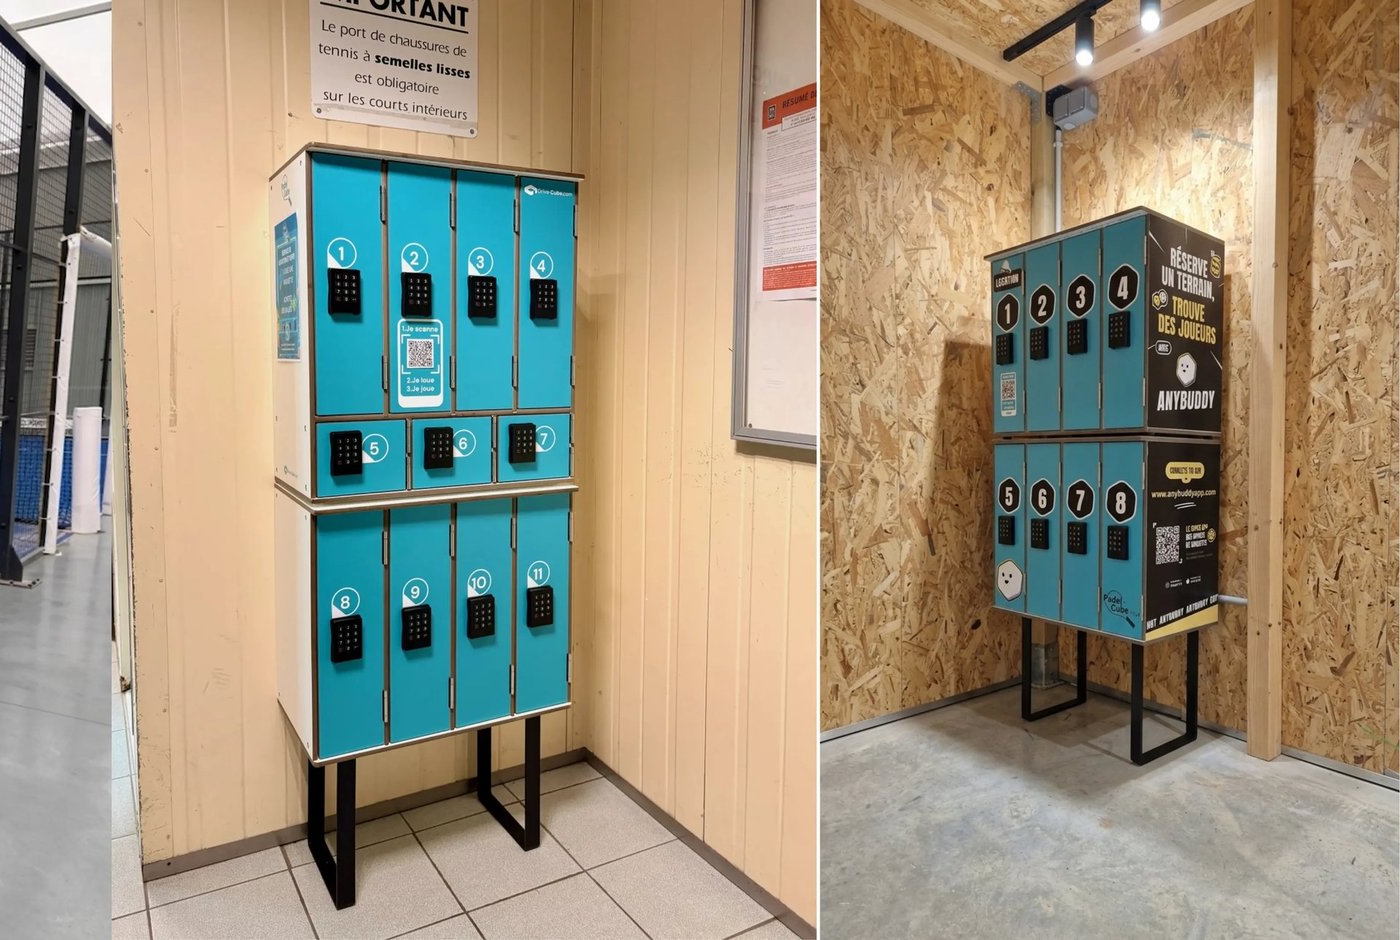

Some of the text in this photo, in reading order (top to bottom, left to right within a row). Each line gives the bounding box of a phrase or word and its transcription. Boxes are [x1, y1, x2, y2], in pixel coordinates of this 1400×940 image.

[338, 0, 469, 27] ORTANT
[321, 20, 467, 58] Le port de chaussures de
[318, 43, 471, 79] tennis à semelles lisses
[354, 73, 440, 95] est obligatoire
[323, 91, 468, 121] sur les courts intérieurs
[338, 246, 345, 261] 1
[410, 251, 419, 266] 2
[476, 255, 485, 269] 3
[1170, 245, 1208, 278] RÉSERVE
[536, 259, 546, 273] 4
[1117, 275, 1129, 300] 4
[1161, 265, 1215, 302] UN TERRAIN,
[1038, 295, 1047, 317] 2
[1075, 285, 1086, 309] 3
[1004, 303, 1011, 325] 1
[1172, 295, 1205, 323] TROUVE
[1158, 313, 1217, 345] DES JOUEURS
[420, 385, 435, 393] joue
[1157, 390, 1215, 411] ANYBUDDY
[369, 441, 380, 456] 5
[458, 437, 468, 450] 6
[540, 432, 548, 446] 7
[1005, 486, 1013, 507] 5
[1038, 488, 1048, 509] 6
[1075, 489, 1086, 512] 7
[1115, 491, 1127, 515] 8
[471, 576, 487, 590] 10
[533, 567, 543, 581] 11
[340, 595, 350, 609] 8
[411, 585, 420, 599] 9
